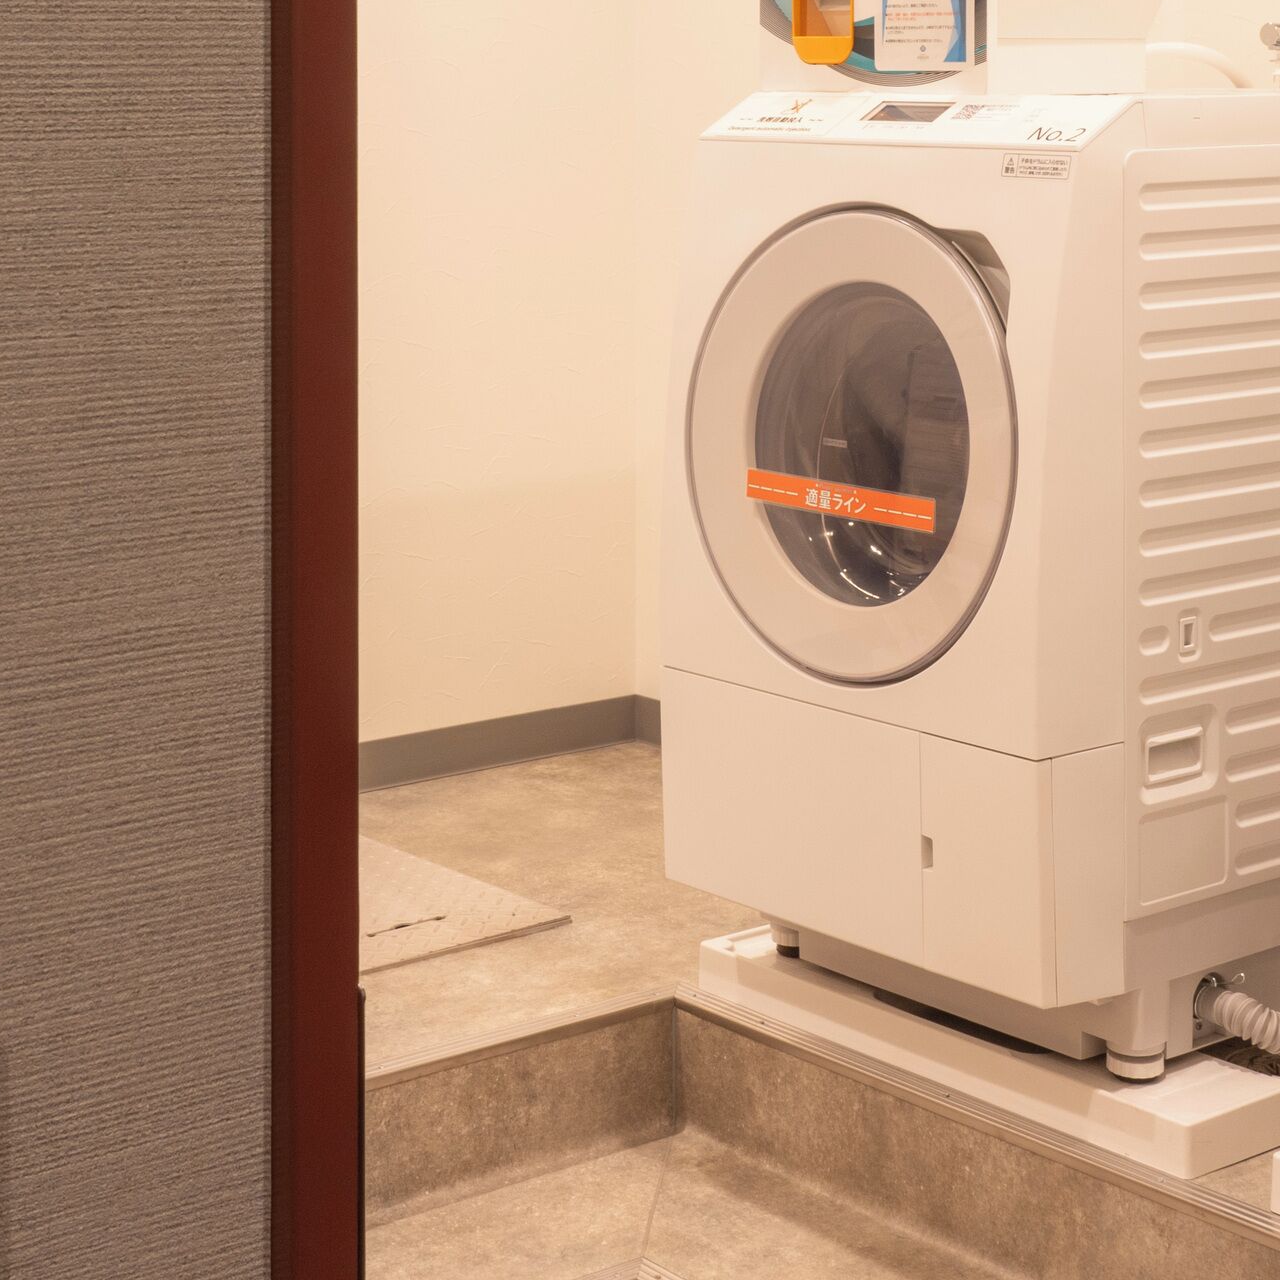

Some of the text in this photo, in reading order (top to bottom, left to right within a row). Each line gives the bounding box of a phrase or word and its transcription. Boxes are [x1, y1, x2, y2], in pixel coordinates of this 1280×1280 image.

[1027, 126, 1087, 142] No.2
[805, 488, 867, 513] 適量ライン
